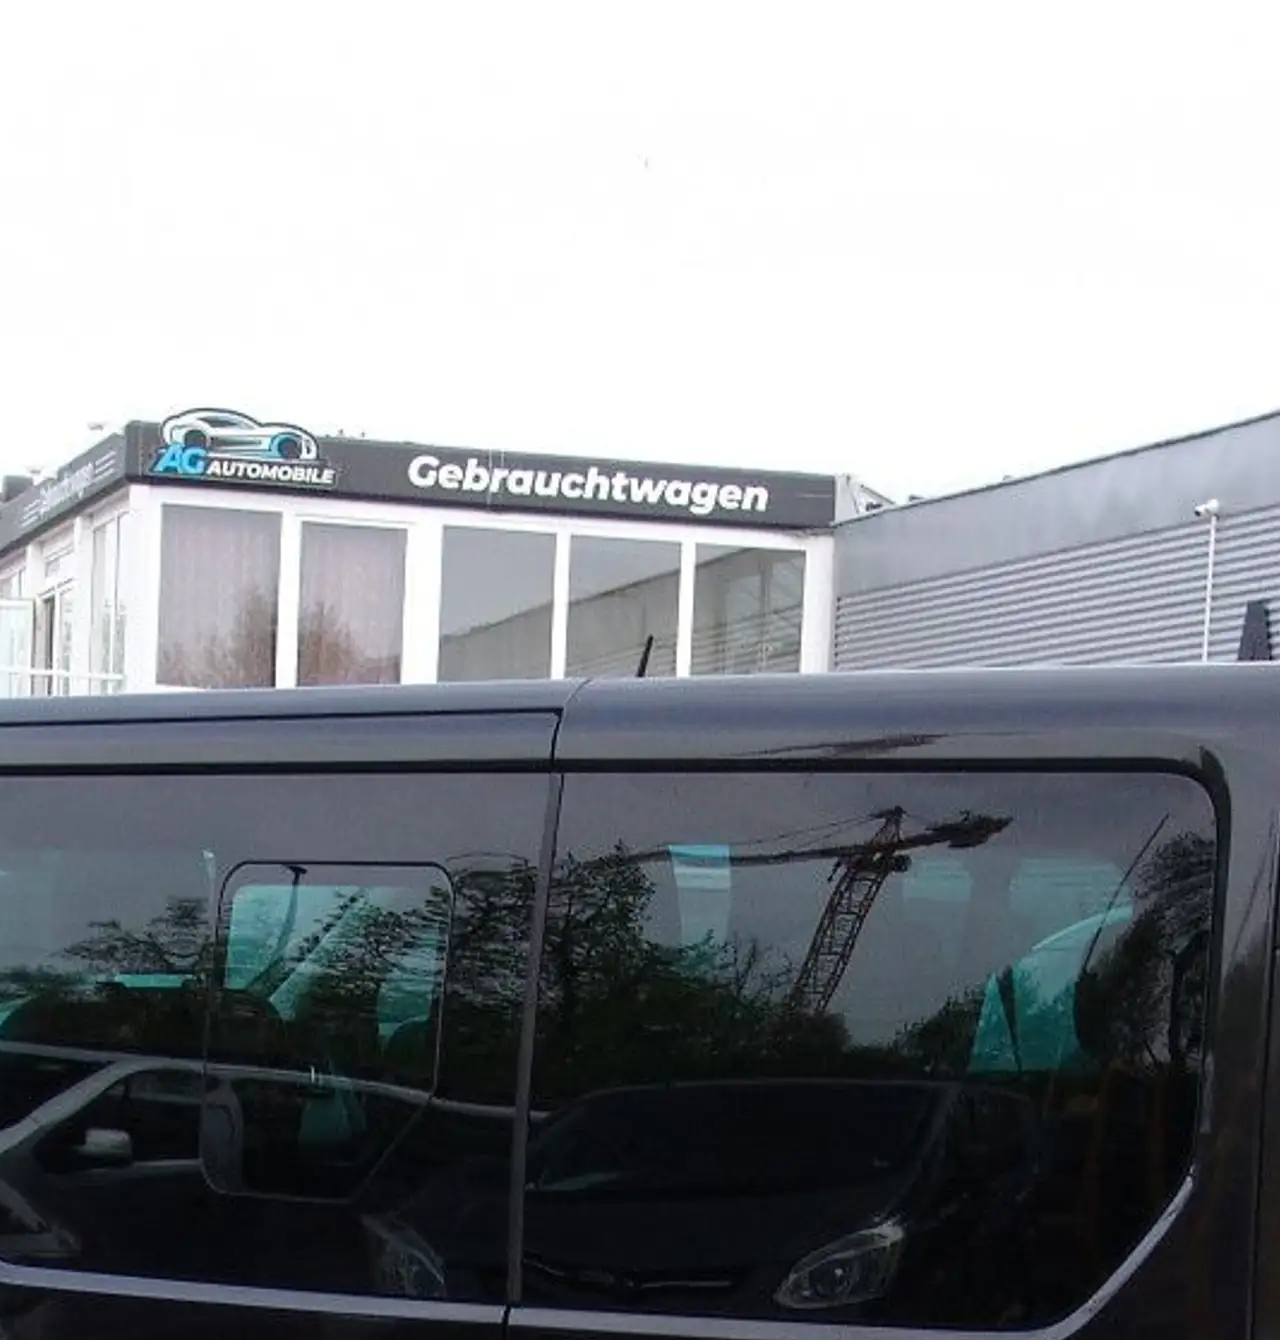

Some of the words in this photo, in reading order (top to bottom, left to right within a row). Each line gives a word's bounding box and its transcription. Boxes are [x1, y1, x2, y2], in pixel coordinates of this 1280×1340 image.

[154, 443, 207, 475] AG
[205, 459, 336, 484] AUTOMOBILE
[407, 454, 770, 516] Gebrauchtwagen
